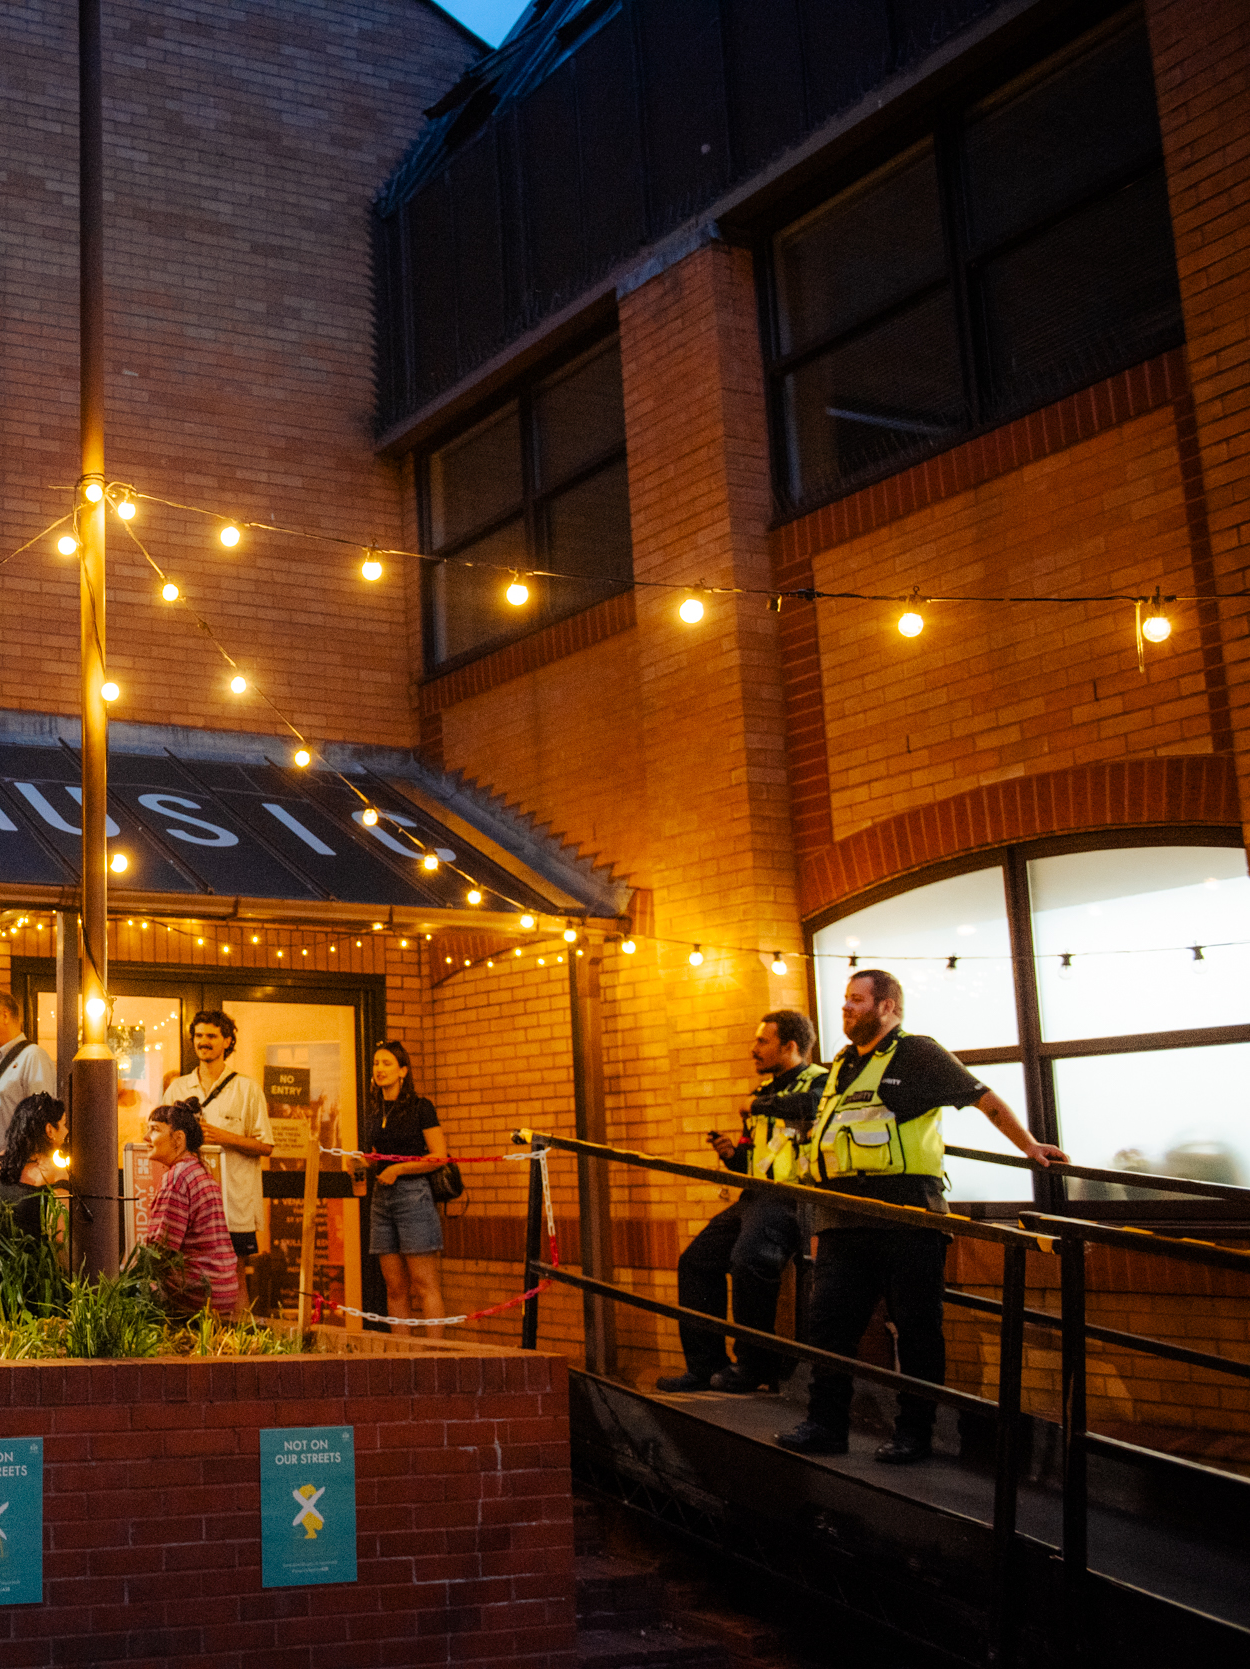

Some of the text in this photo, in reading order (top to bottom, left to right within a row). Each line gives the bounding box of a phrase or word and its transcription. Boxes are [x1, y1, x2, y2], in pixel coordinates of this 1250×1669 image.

[279, 1075, 295, 1084] NO
[271, 1085, 302, 1096] ENTRY
[135, 1184, 148, 1246] RIDAY
[284, 1439, 329, 1452] NOT ON
[275, 1452, 341, 1465] OUR STREETS
